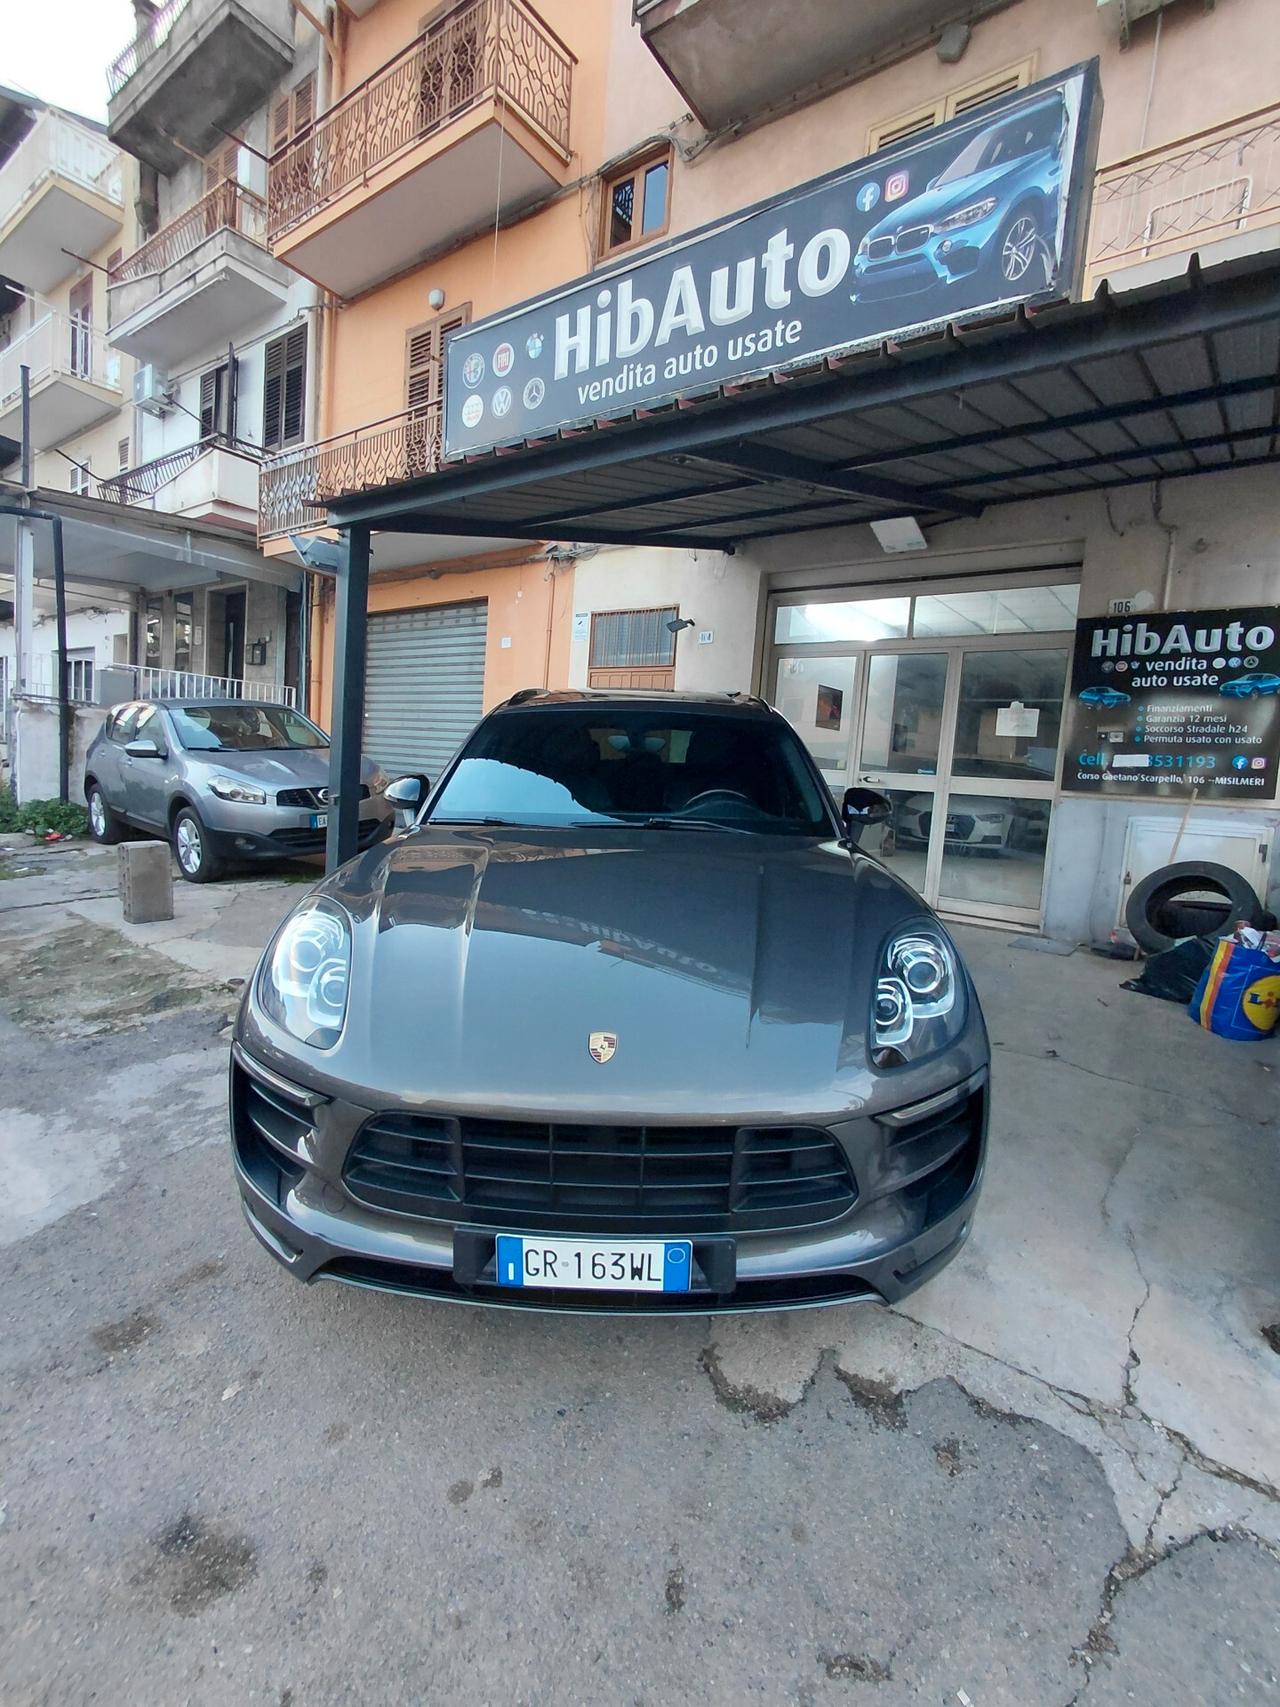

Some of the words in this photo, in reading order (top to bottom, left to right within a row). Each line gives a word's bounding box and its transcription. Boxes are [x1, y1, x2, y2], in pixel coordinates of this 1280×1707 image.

[554, 228, 851, 381] HibAuto
[577, 363, 656, 405] vendita
[664, 343, 718, 380] auto
[728, 318, 802, 362] usate
[1113, 601, 1131, 614] 106
[1091, 621, 1275, 657] HibAuto
[1145, 657, 1207, 671] vendita
[1131, 675, 1168, 688] auto
[1173, 673, 1219, 687] usate
[1146, 704, 1213, 713] Finanziamenti
[1145, 714, 1186, 723] Garanzia
[1189, 715, 1200, 723] 12
[1203, 714, 1227, 723] mesi
[1144, 725, 1184, 733] Soccorso
[1186, 724, 1226, 733] Stradale
[1228, 724, 1248, 733] h24
[1143, 735, 1183, 743] Permuta
[1185, 736, 1212, 744] usato
[1234, 735, 1263, 744] usato
[1077, 772, 1100, 781] Corso
[1101, 772, 1138, 782] Gaetano
[1187, 775, 1205, 784] 106
[525, 1249, 558, 1278] GR
[574, 1252, 662, 1282] 163WL
